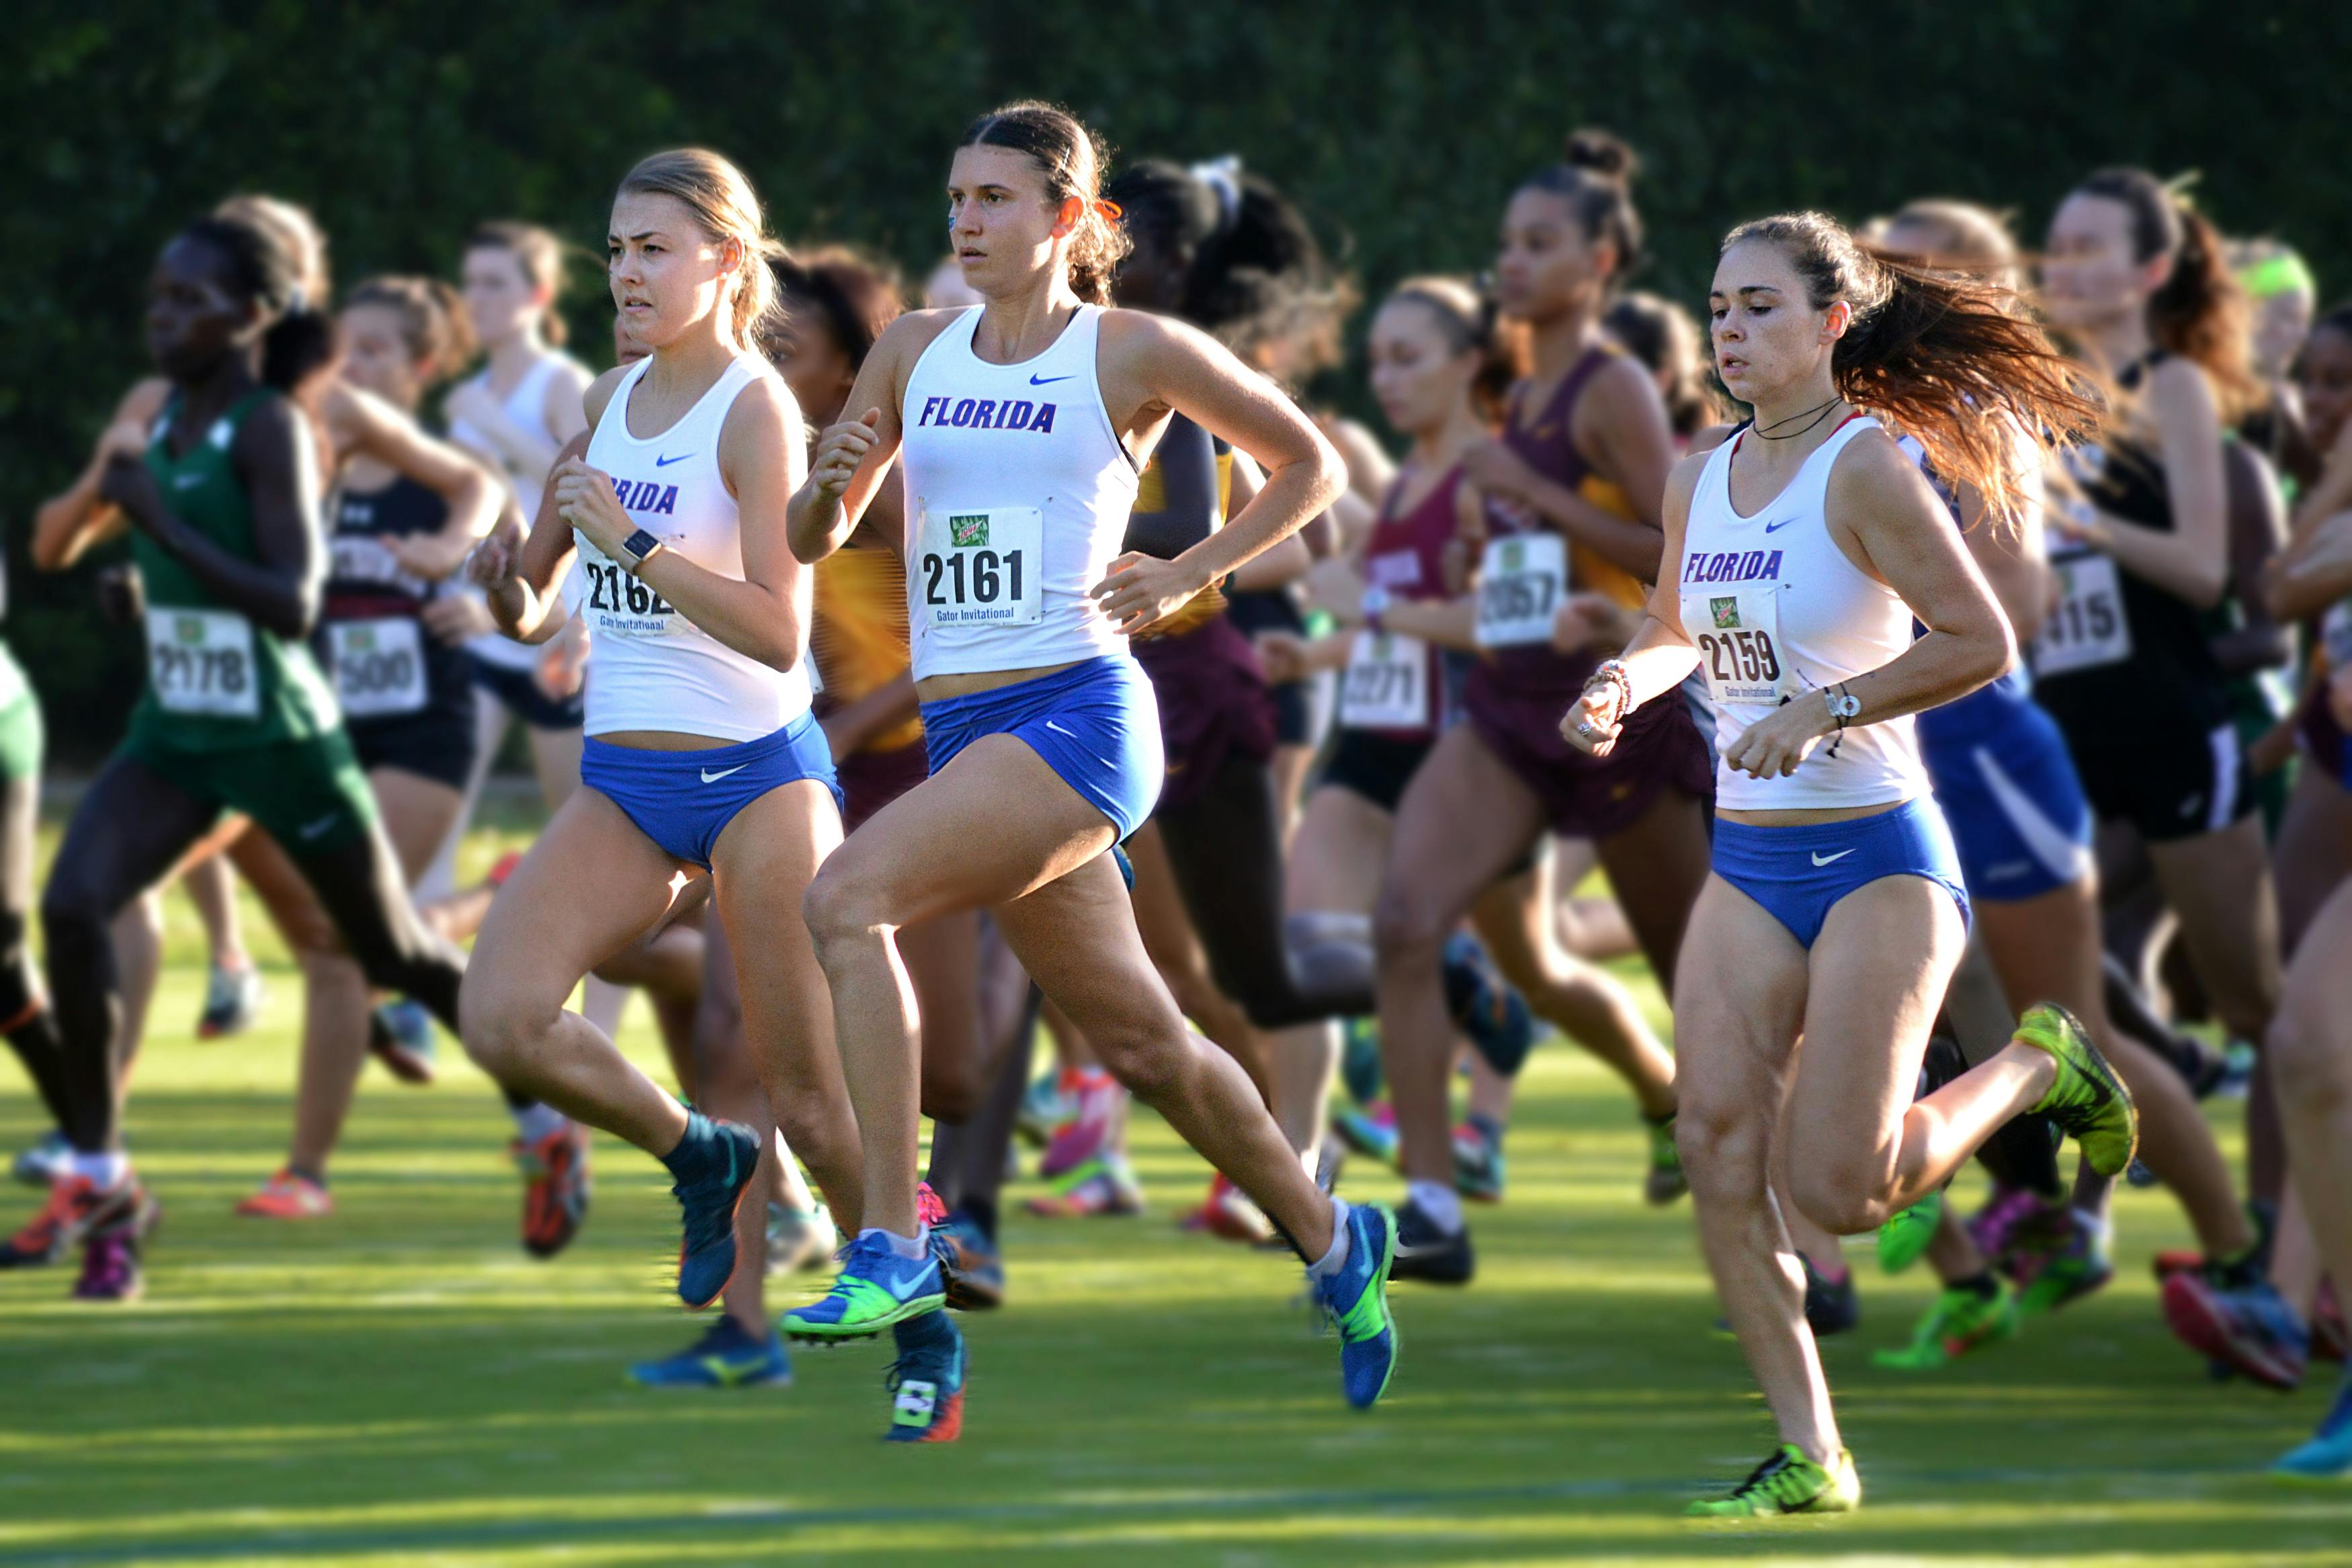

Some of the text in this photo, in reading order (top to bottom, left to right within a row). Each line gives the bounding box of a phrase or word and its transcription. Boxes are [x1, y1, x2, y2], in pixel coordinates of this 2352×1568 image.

[918, 396, 1057, 433] FLORIDA
[610, 477, 679, 515] RIDA
[923, 550, 1022, 605] 2161
[1683, 550, 1783, 582] FLORIDA
[936, 607, 1015, 621] Gator Invitational
[156, 643, 247, 696] 2178
[1698, 630, 1780, 681] 2159
